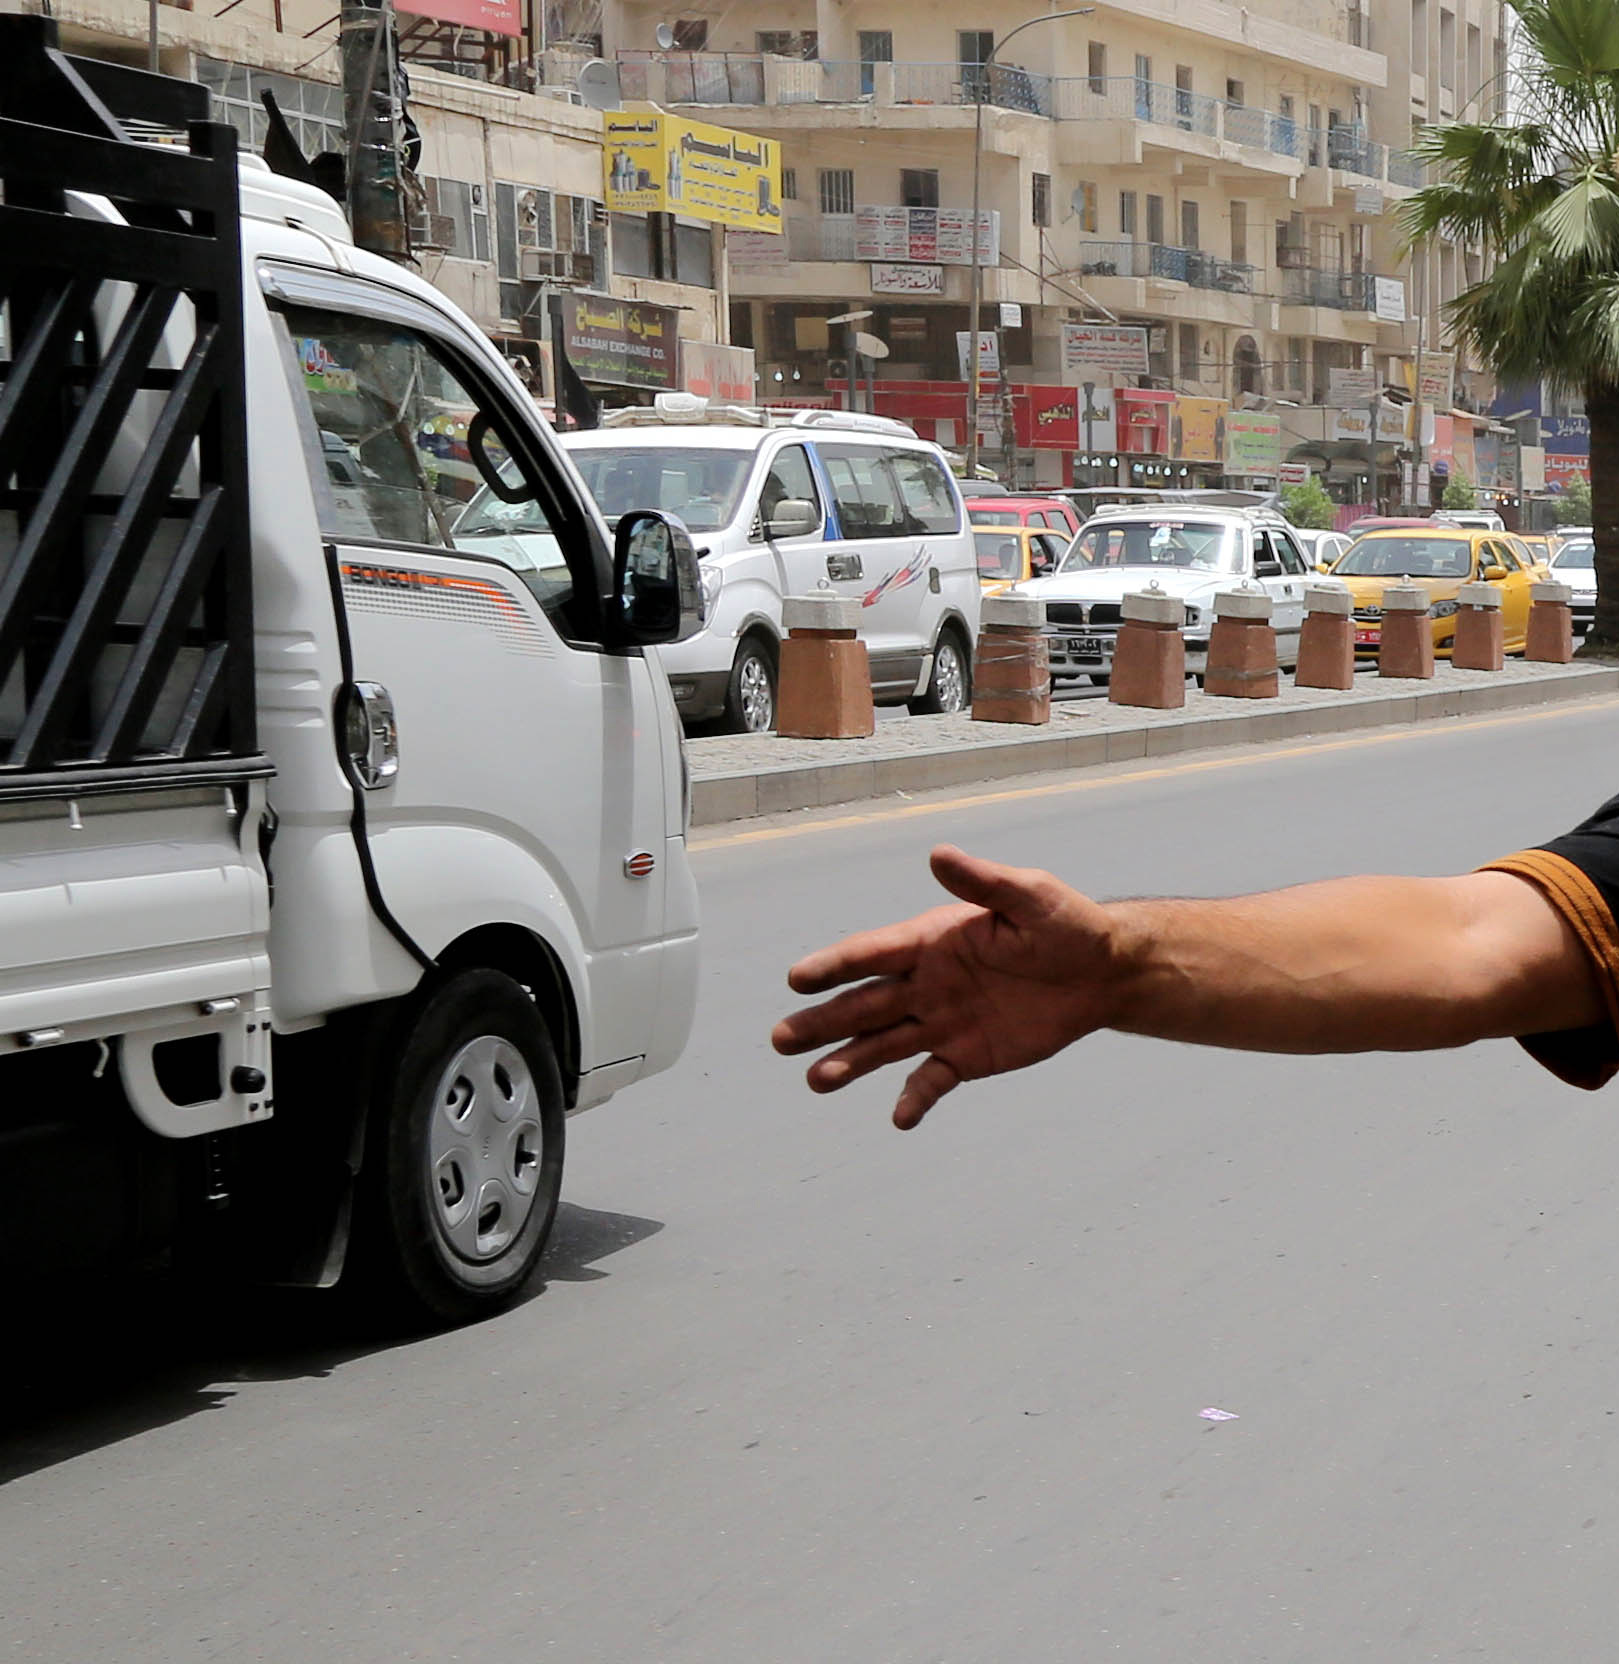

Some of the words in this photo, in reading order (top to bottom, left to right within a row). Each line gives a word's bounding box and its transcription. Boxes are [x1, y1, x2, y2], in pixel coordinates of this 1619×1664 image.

[680, 132, 769, 171] الباسم
[627, 307, 664, 341] شركة
[570, 335, 608, 352] ALSABAH
[609, 340, 651, 358] EXCHANGE
